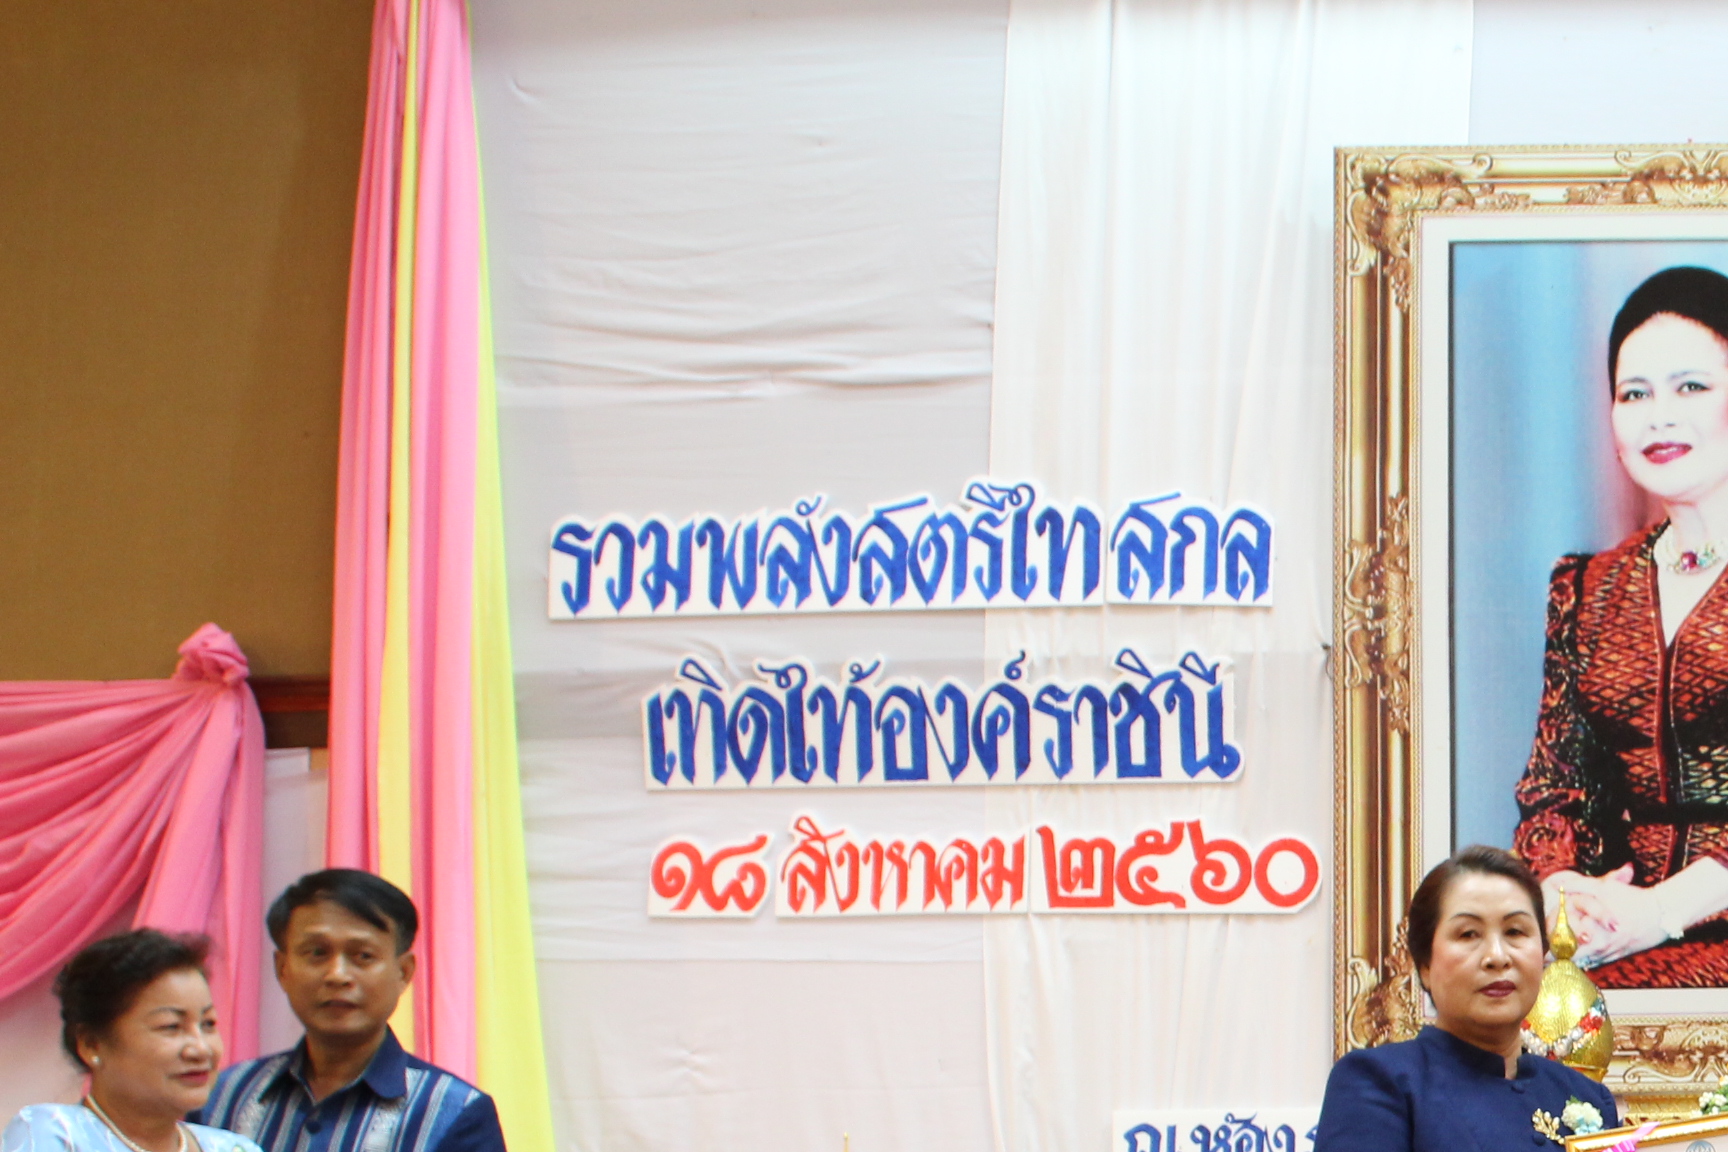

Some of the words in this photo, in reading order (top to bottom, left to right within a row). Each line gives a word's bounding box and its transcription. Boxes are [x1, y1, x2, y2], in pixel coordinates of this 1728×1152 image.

[646, 648, 1241, 784] เทิดไท้องค์ราชินี
